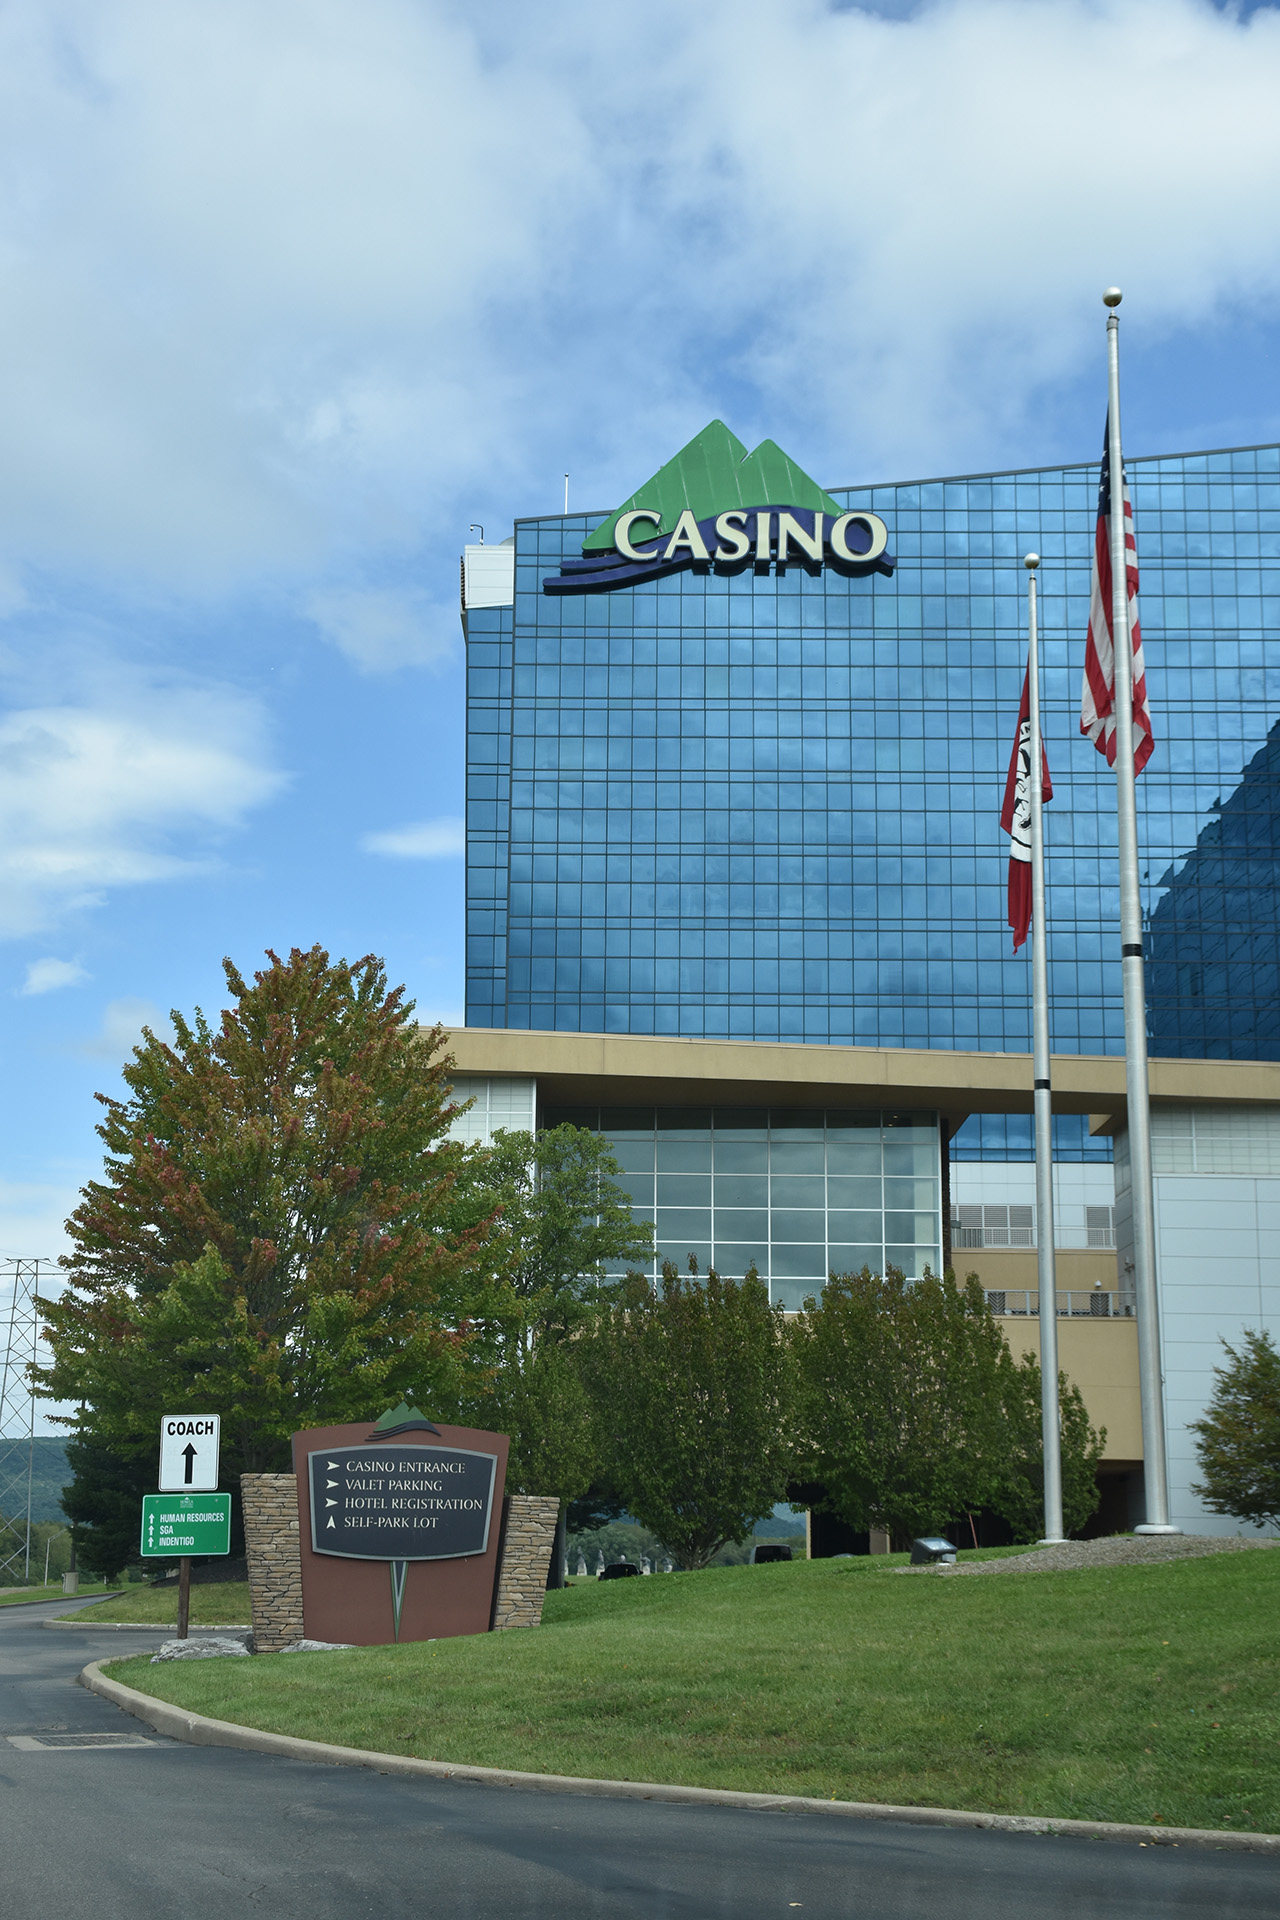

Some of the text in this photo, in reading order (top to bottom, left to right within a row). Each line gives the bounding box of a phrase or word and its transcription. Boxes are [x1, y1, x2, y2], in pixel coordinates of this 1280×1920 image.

[613, 508, 889, 563] CASINO
[167, 1421, 214, 1435] COACH
[346, 1460, 466, 1474] CASINO ENTRANCE
[345, 1479, 443, 1492] VALET PARKING
[345, 1497, 483, 1511] HOTEL REGISTRATION
[160, 1512, 225, 1523] HUMAN RESOURCES
[344, 1516, 439, 1529] SELF-PARK LOT
[159, 1525, 174, 1535] SGA
[159, 1536, 195, 1546] INDENTIGO
